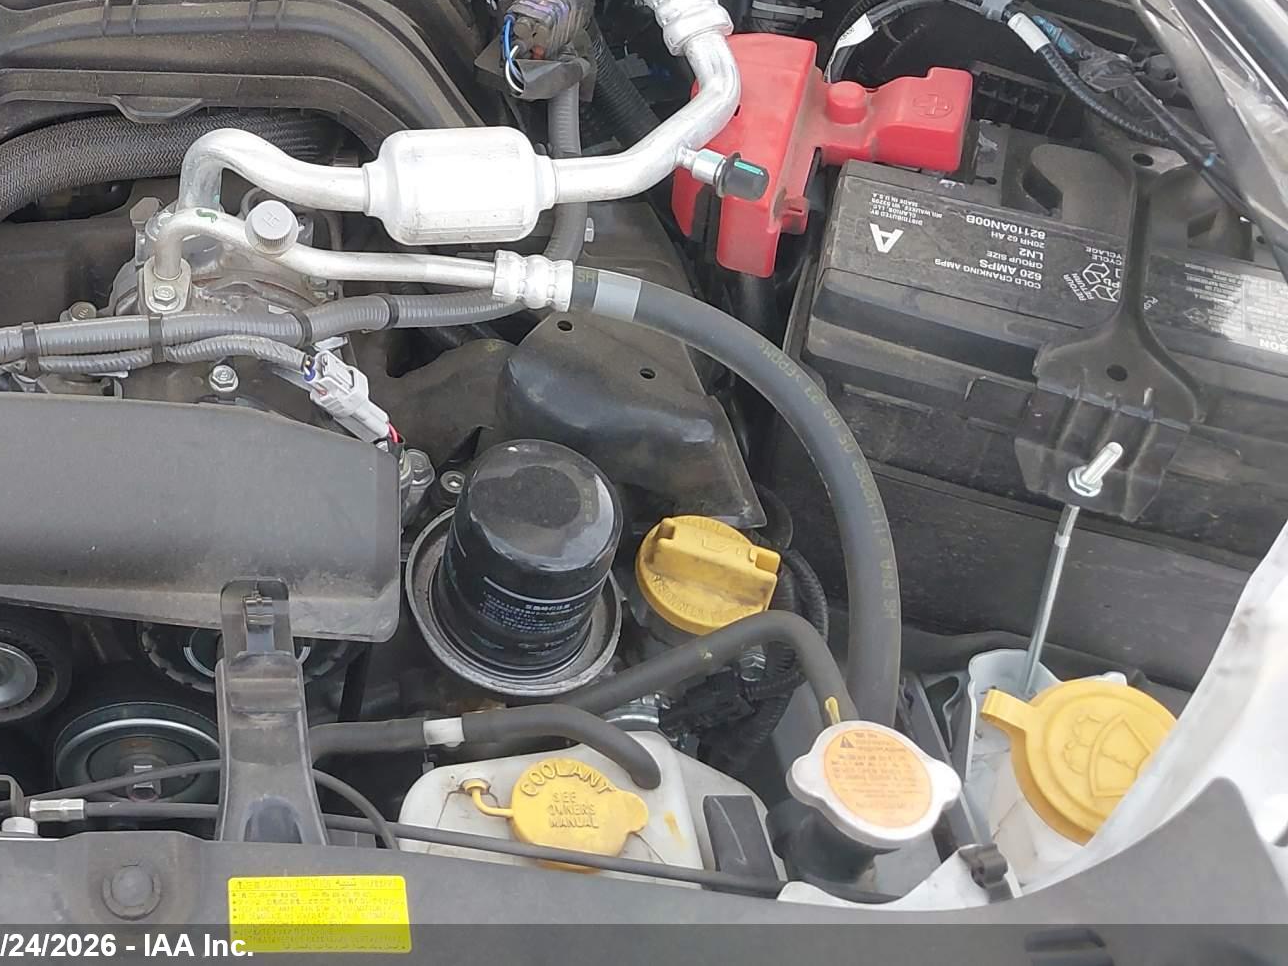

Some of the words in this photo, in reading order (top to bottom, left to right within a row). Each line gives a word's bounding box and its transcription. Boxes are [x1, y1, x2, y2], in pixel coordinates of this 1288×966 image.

[965, 214, 1046, 240] 82110AN00B
[990, 230, 1005, 240] AH
[1006, 233, 1019, 243] 62
[1020, 236, 1045, 249] 20HR
[985, 250, 1008, 261] SIZE
[1018, 246, 1044, 261] LN2
[1084, 245, 1122, 258] YCLAGE
[934, 257, 961, 270] AMPS
[1008, 255, 1044, 269] GROUP
[1090, 253, 1122, 265] CYCLE
[978, 258, 1017, 275] AMPS
[962, 264, 1013, 283] CRANKING
[1019, 268, 1043, 281] 620
[1014, 277, 1042, 289] COLD
[1062, 273, 1086, 301] RETOUR
[1071, 272, 1094, 299] RETURN
[520, 760, 614, 797] COOLANT
[552, 792, 577, 804] SEE
[548, 804, 596, 817] OWNERS
[549, 817, 599, 829] MANUAL
